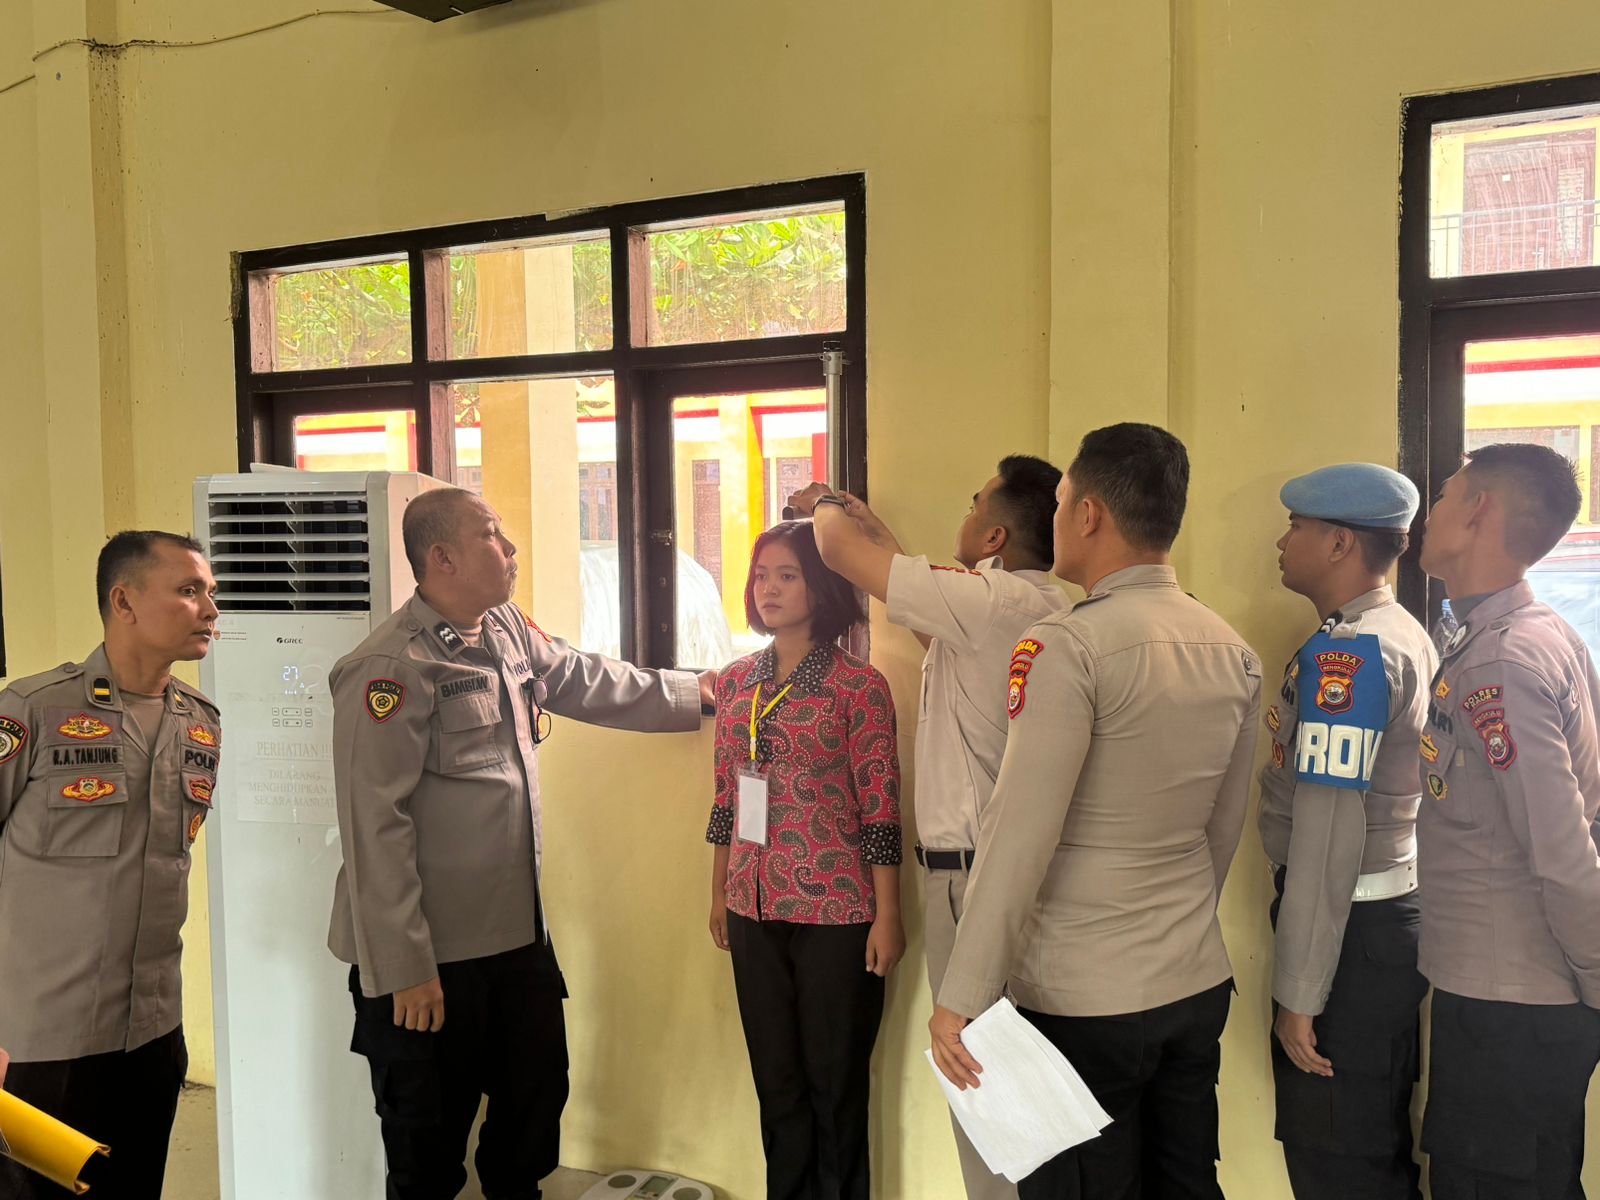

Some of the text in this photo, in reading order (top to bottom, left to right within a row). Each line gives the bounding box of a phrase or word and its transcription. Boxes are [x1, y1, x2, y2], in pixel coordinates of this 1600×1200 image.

[1319, 653, 1357, 666] POLDA
[283, 666, 298, 681] 27
[1464, 687, 1498, 709] POLRES
[256, 741, 319, 758] PERHATIAN
[269, 769, 321, 781] DILARANG
